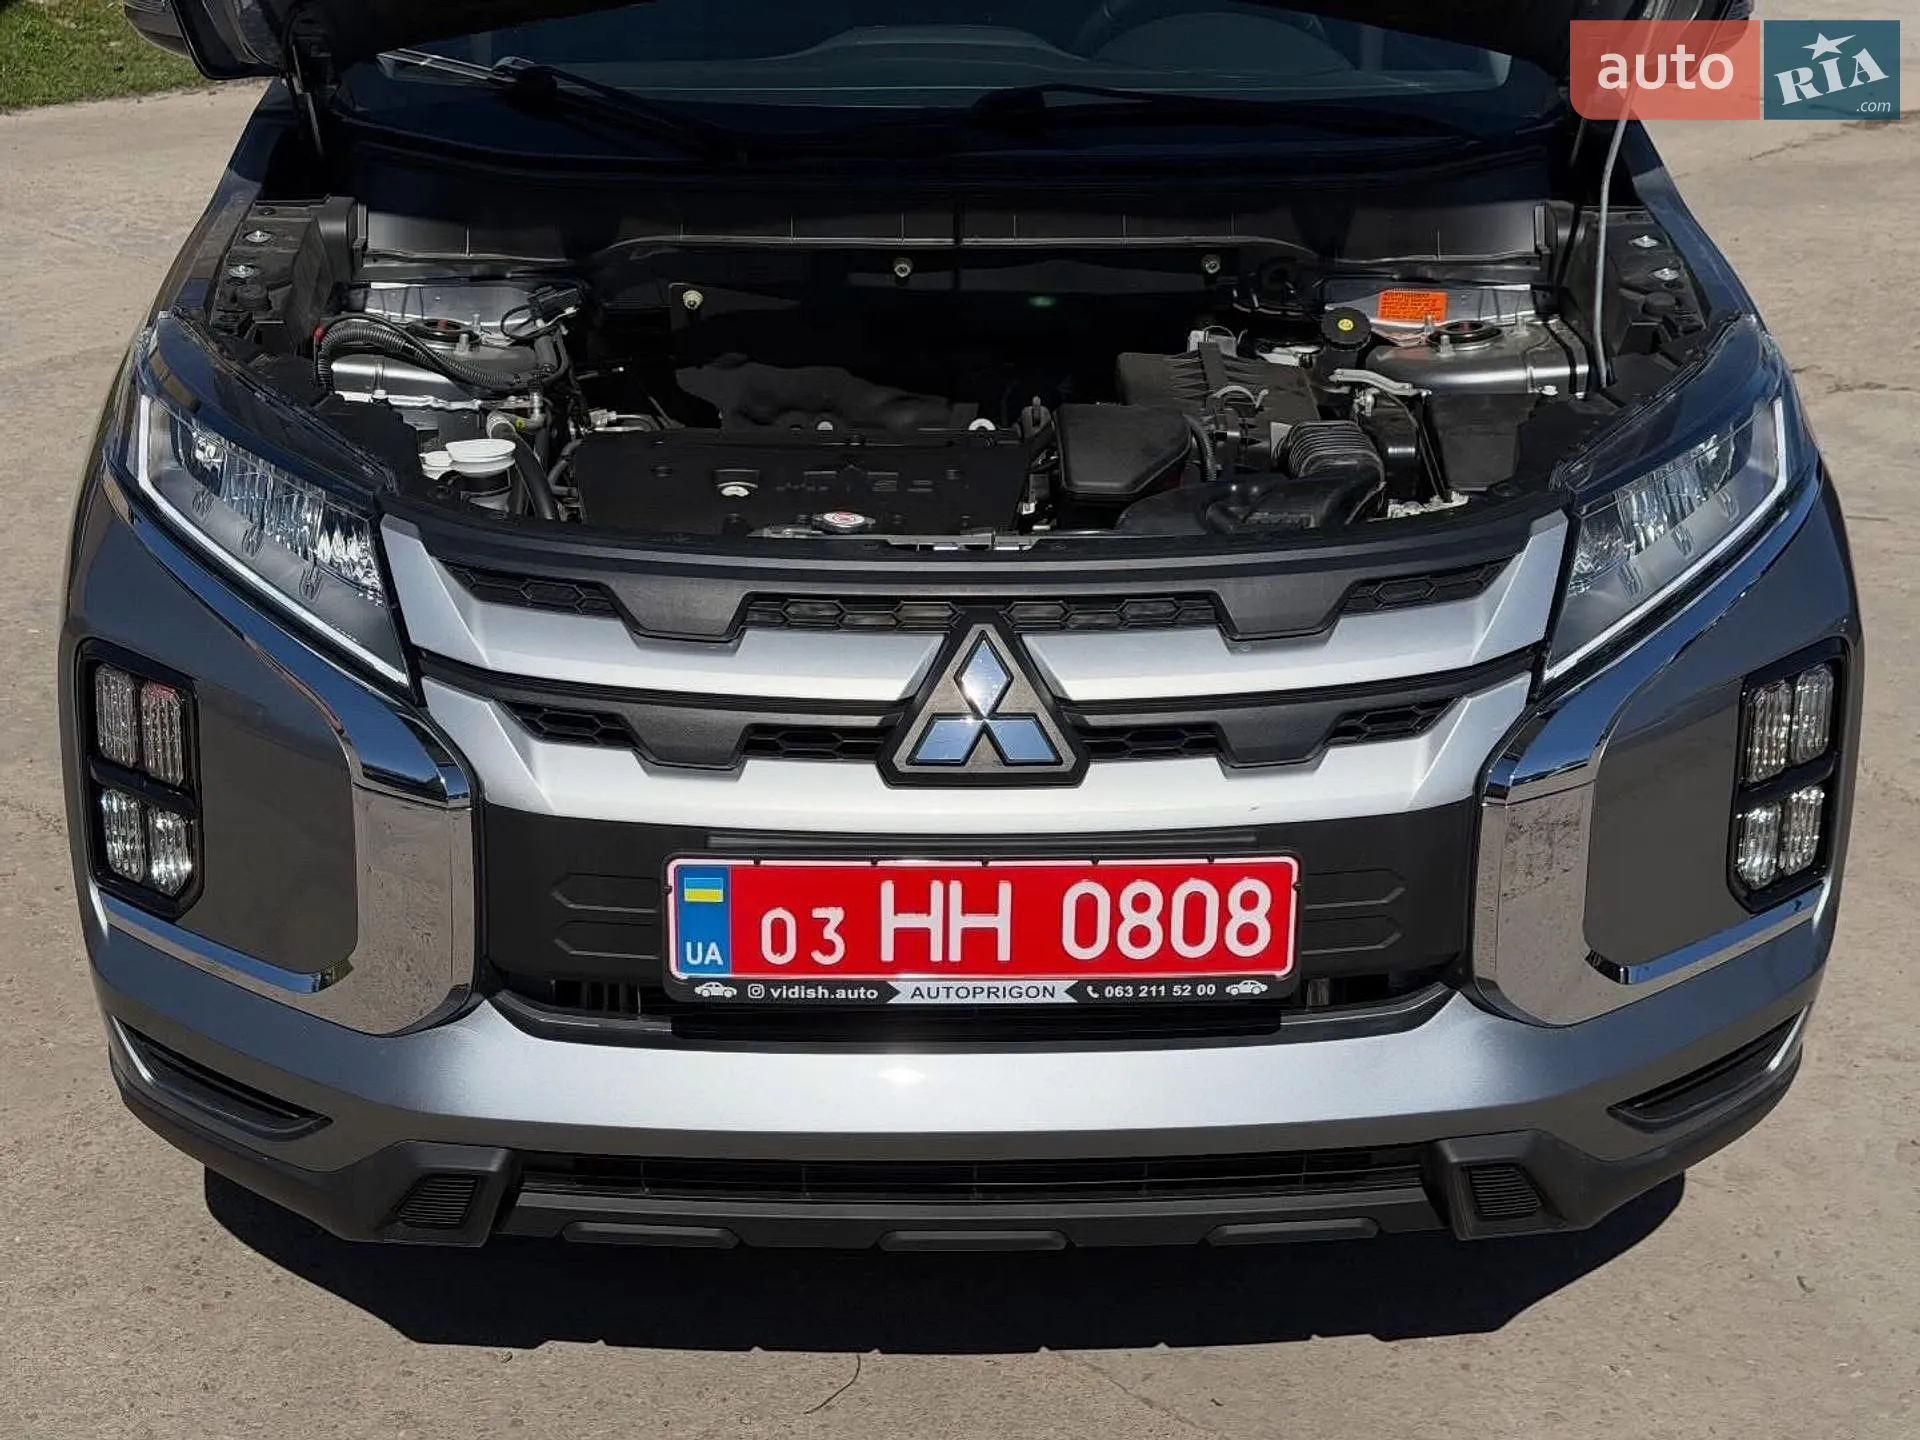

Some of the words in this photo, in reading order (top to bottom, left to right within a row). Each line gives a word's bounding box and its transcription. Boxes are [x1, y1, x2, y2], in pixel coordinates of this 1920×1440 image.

[760, 906, 845, 966] 03
[880, 879, 1012, 963] HH
[1061, 877, 1273, 962] 0808
[685, 942, 724, 965] UA
[770, 985, 879, 999] vidish.auto
[910, 985, 1056, 999] AUTOPRIGON
[1104, 985, 1133, 998] 063
[1138, 985, 1166, 998] 211
[1172, 984, 1192, 997] 52
[1196, 983, 1216, 996] 00
